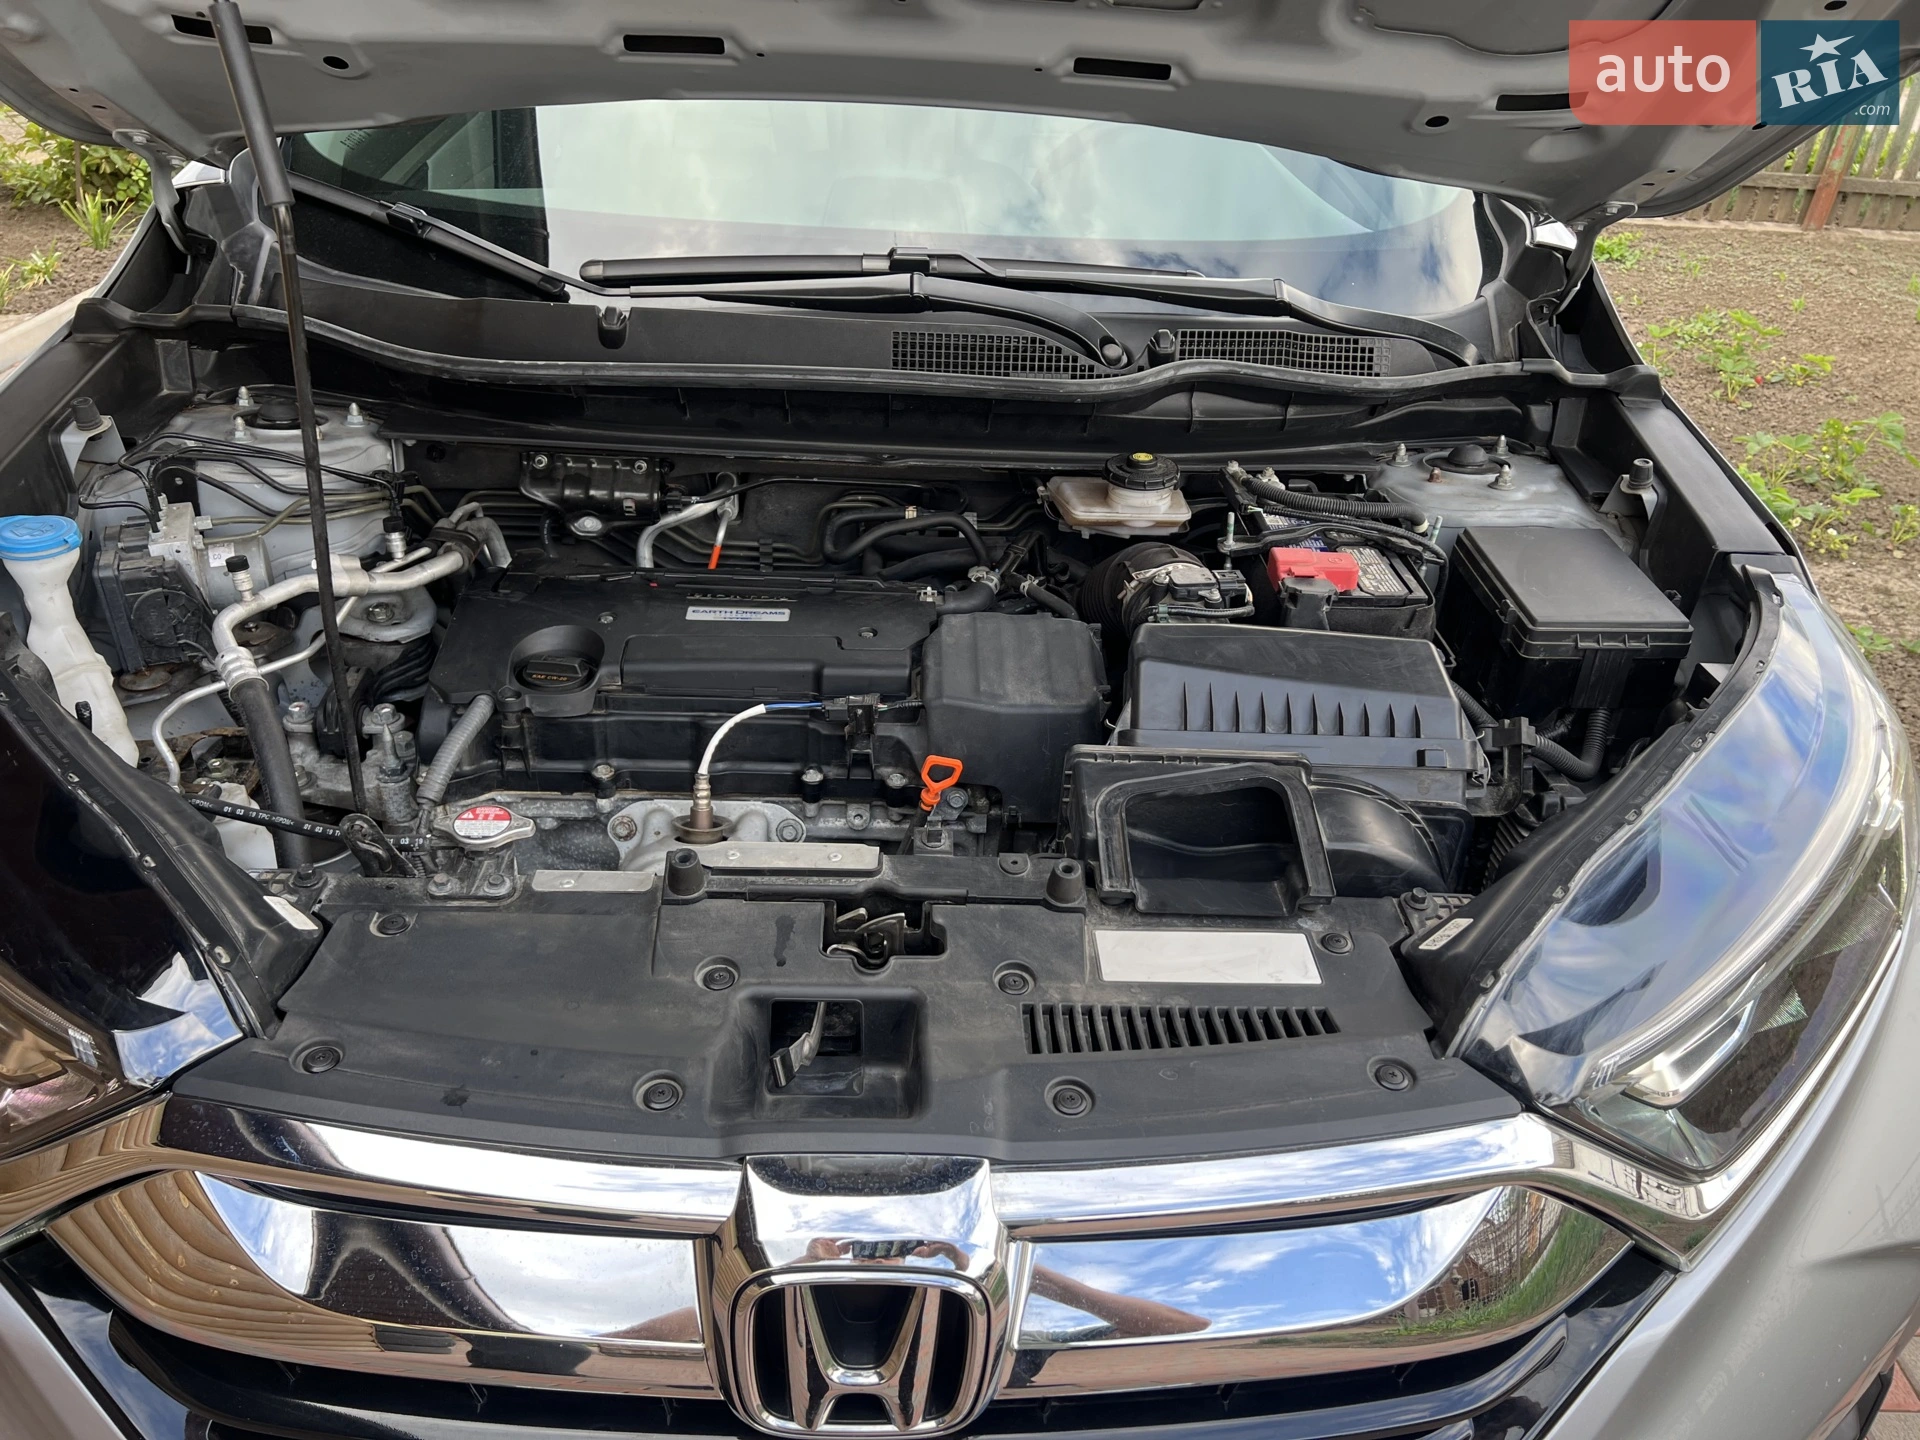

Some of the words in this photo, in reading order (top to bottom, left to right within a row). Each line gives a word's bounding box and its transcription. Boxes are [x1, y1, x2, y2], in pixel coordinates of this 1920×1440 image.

[236, 808, 245, 816] 03
[258, 812, 271, 820] TPC
[400, 837, 410, 845] 03
